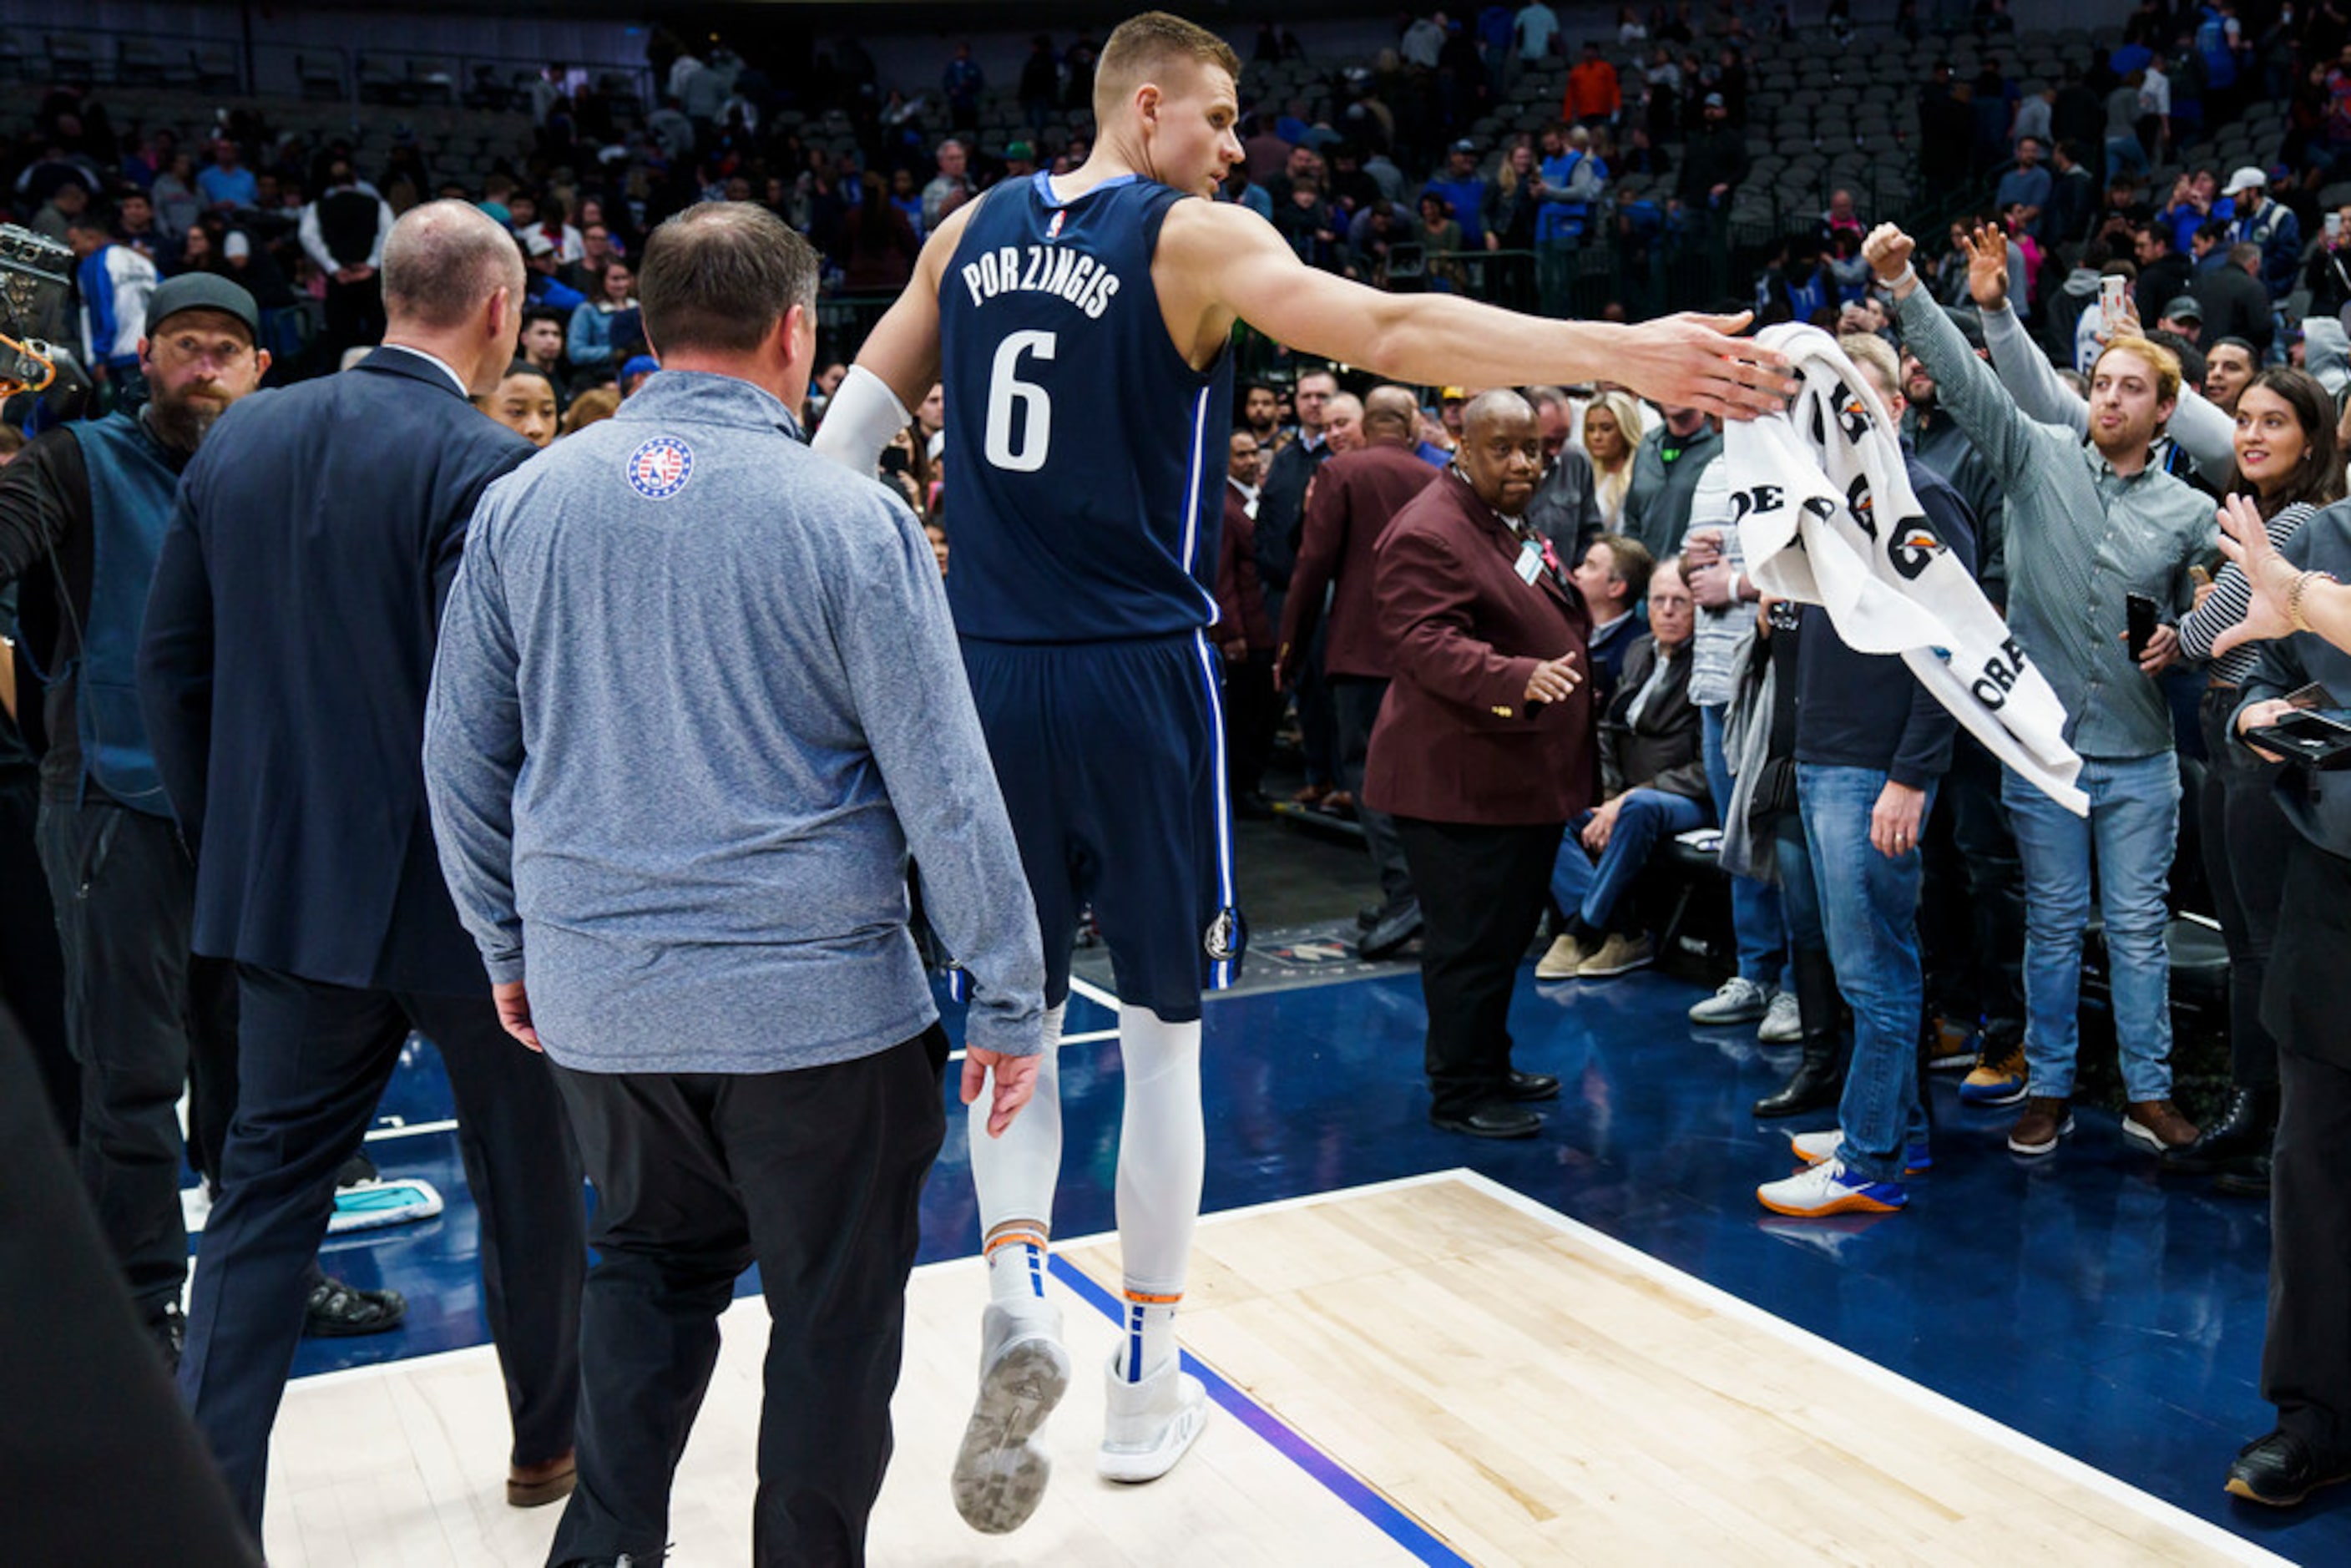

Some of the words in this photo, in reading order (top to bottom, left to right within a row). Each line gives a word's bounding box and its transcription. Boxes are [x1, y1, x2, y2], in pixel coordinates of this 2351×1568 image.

[962, 245, 1120, 319] PORZINGIS
[984, 330, 1057, 473] 6
[1888, 515, 1948, 580] G
